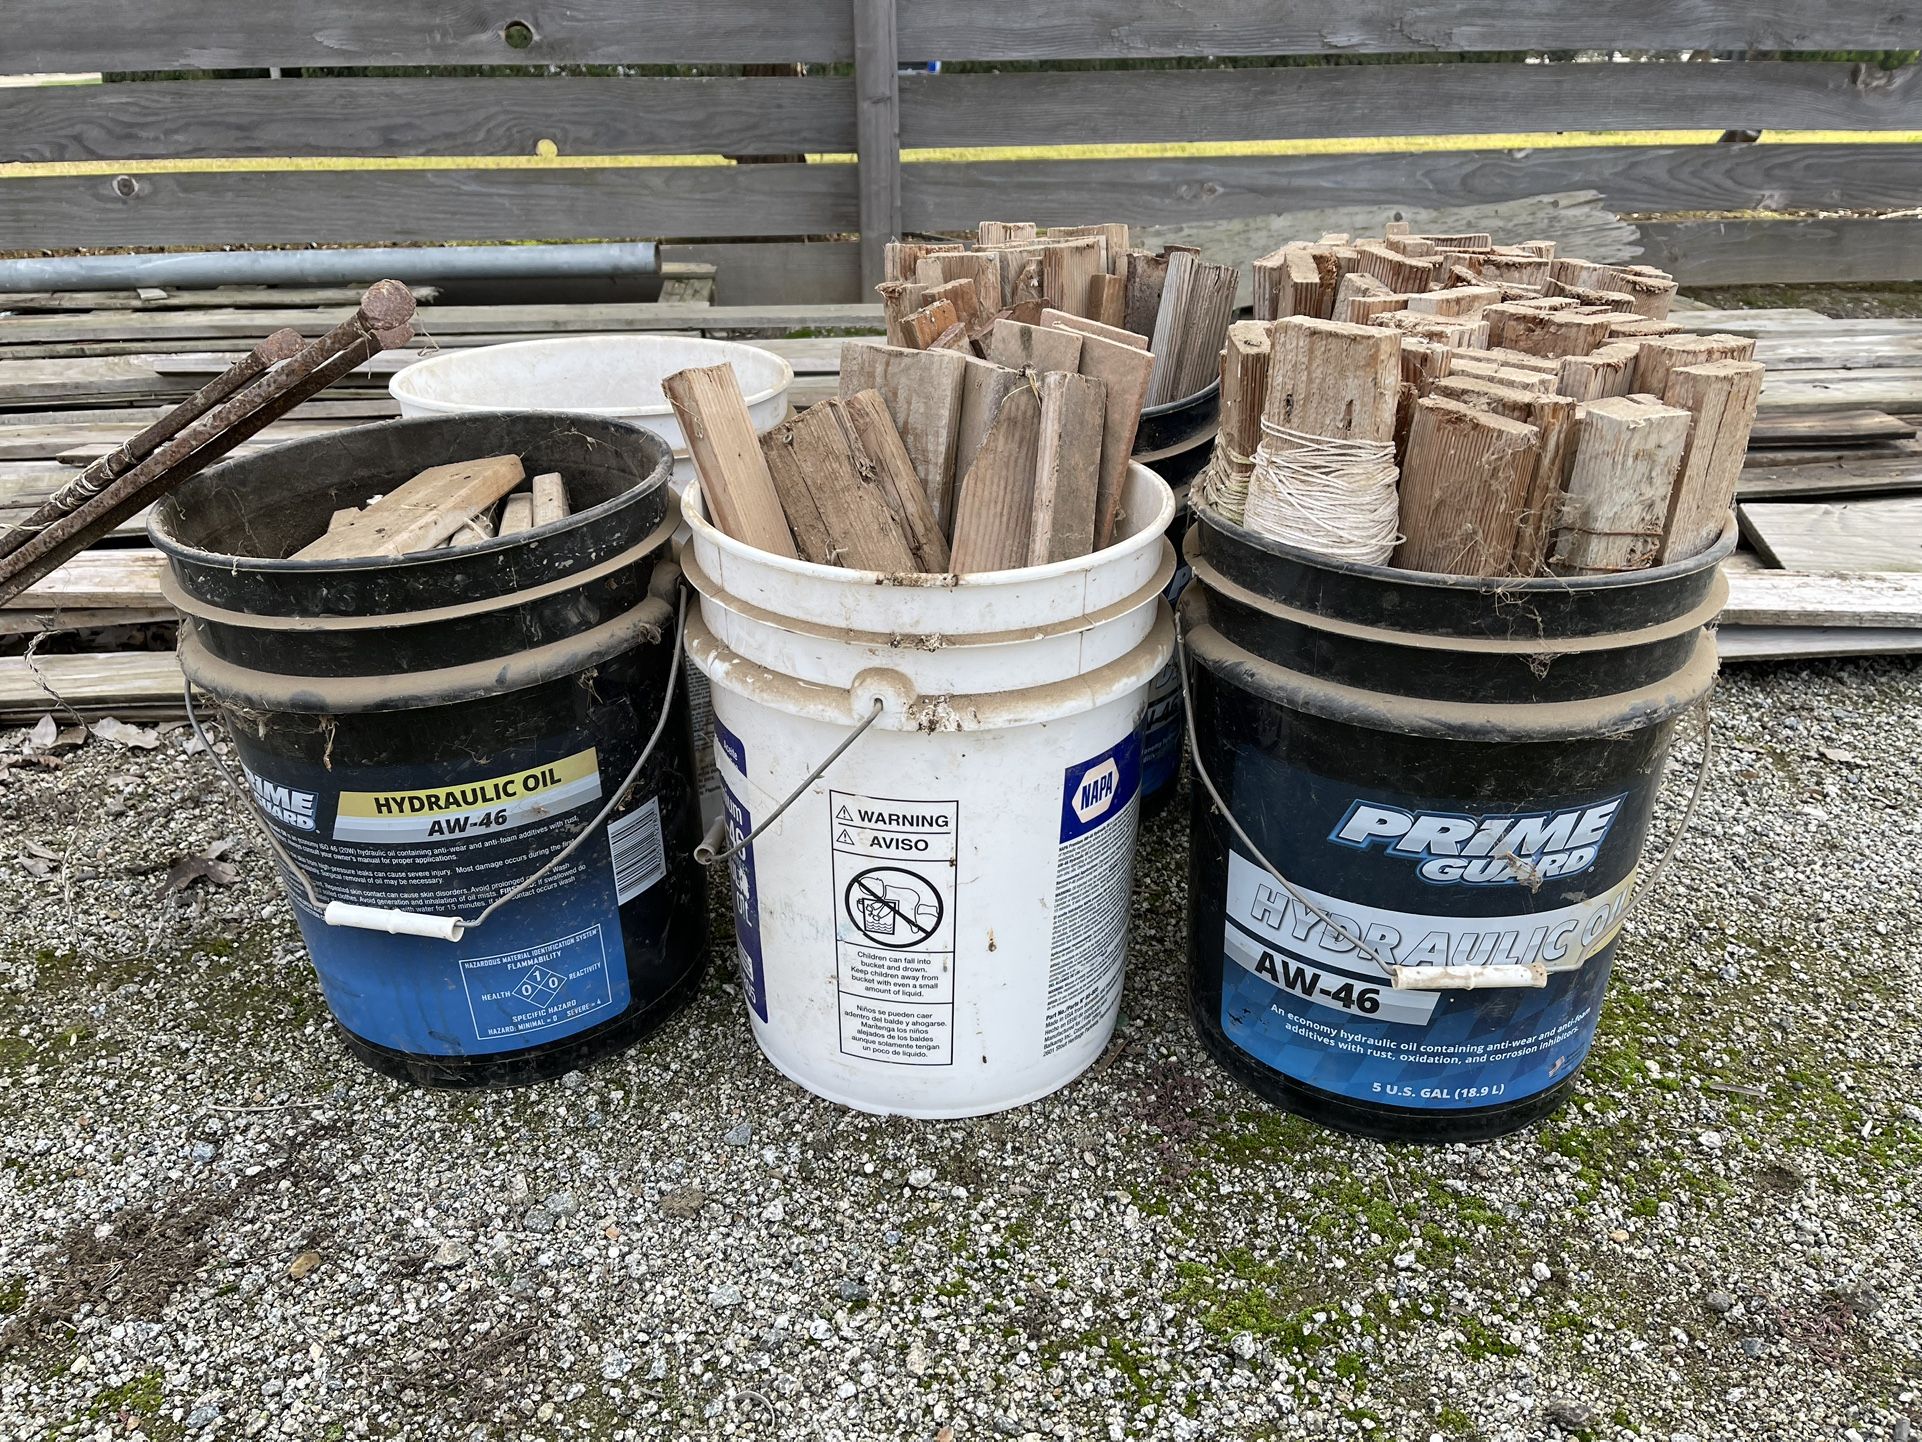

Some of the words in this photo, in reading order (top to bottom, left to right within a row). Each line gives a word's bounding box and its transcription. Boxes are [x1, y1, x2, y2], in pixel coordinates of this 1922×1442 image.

[374, 780, 517, 814] HYDRAULIC
[522, 768, 561, 794] OIL
[1080, 771, 1113, 811] NAPA
[428, 809, 507, 837] AW-46
[857, 809, 949, 828] WARNING
[1339, 799, 1621, 856] PRIME
[357, 848, 386, 857] hydraulic
[397, 848, 432, 857] containing
[433, 845, 467, 854] anti-wear
[469, 842, 482, 850] and
[484, 834, 517, 847] anti-foam
[518, 825, 548, 839] additives
[549, 820, 564, 830] with
[564, 815, 579, 825] rust,
[869, 835, 929, 852] AVISO
[333, 853, 356, 861] owner's
[392, 857, 413, 865] proper
[414, 854, 458, 864] applications.
[356, 869, 373, 877] leaks
[407, 870, 430, 878] severe
[431, 869, 453, 877] injury.
[455, 865, 474, 874] Most
[475, 861, 503, 871] damage
[504, 854, 527, 865] occurs
[528, 848, 549, 859] during
[550, 844, 561, 852] the
[1422, 846, 1595, 882] GUARD
[343, 875, 366, 883] removal
[409, 877, 444, 885] necessary.
[350, 888, 362, 896] skin
[363, 890, 386, 898] contact
[400, 891, 419, 899] cause
[435, 888, 470, 897] disorders.
[470, 884, 490, 893] Avoid
[491, 876, 525, 890] prolonged
[552, 863, 570, 873] Wash
[425, 896, 457, 905] inhalation
[478, 891, 498, 900] mists.
[544, 867, 577, 883] swallowed
[578, 864, 586, 872] do
[458, 901, 487, 910] minutes.
[536, 883, 557, 893] occurs
[558, 876, 575, 886] wash
[1250, 883, 1578, 967] HYDRAULIC
[464, 959, 500, 969] HAZARDOUS
[502, 952, 531, 964] MATERIAL
[531, 937, 575, 957] IDENTIFICATION
[576, 928, 598, 942] SYSTEM
[857, 951, 887, 961] Children
[507, 950, 562, 970] FLAMMABILITY
[860, 960, 885, 969] bucket
[886, 964, 901, 972] and
[902, 965, 928, 973] drown.
[532, 970, 541, 982] 1
[568, 961, 601, 980] REACTIVITY
[850, 965, 869, 975] Keep
[870, 970, 899, 979] children
[900, 974, 920, 982] away
[851, 974, 875, 984] bucket
[521, 984, 532, 996] 0
[548, 977, 559, 989] 0
[1254, 950, 1381, 1014] AW-46
[481, 990, 511, 1001] HEALTH
[864, 986, 891, 994] amount
[901, 989, 924, 998] liquid.
[512, 1009, 546, 1023] SPECIFIC
[548, 999, 577, 1014] HAZARD
[567, 1004, 589, 1017] SEVERE
[844, 1010, 870, 1020] adentro
[884, 1017, 904, 1025] balde
[911, 1020, 947, 1028] ahogarse.
[856, 1004, 877, 1014] Niños
[887, 1011, 915, 1019] pueden
[1045, 1018, 1059, 1028] Made
[1065, 1010, 1074, 1020] USA
[1046, 1012, 1057, 1021] Part
[488, 1024, 516, 1035] HAZARD:
[518, 1018, 545, 1030] MINIMAL
[856, 1028, 885, 1039] alejados
[860, 1020, 896, 1032] Mantenga
[1044, 1023, 1075, 1042] Manufactured
[1045, 1025, 1060, 1035] Hecho
[1271, 1003, 1285, 1016] An
[1287, 1012, 1338, 1037] economy
[1340, 1029, 1398, 1049] hydraulic
[1400, 1042, 1417, 1051] oil
[1420, 1044, 1485, 1054] containing
[1486, 1034, 1538, 1052] anti-wear
[1538, 1026, 1557, 1041] and
[1557, 1007, 1591, 1033] anti-foam
[851, 1035, 876, 1045] aunque
[877, 1039, 914, 1049] solamente
[915, 1043, 940, 1051] tengan
[872, 1047, 890, 1055] poco
[1043, 1037, 1064, 1050] Balkamp
[1285, 1022, 1335, 1046] additives
[1338, 1041, 1364, 1054] with
[1367, 1048, 1396, 1061] rust,
[1400, 1053, 1462, 1065] oxidation,
[1465, 1053, 1487, 1064] and
[1489, 1045, 1538, 1061] corrosion
[1539, 1026, 1579, 1050] inhibitors.
[1372, 1081, 1382, 1092] 5
[1386, 1084, 1416, 1098] U.S.
[1420, 1088, 1451, 1099] GAL
[1454, 1086, 1489, 1100] (18.9
[1491, 1083, 1505, 1095] L)
